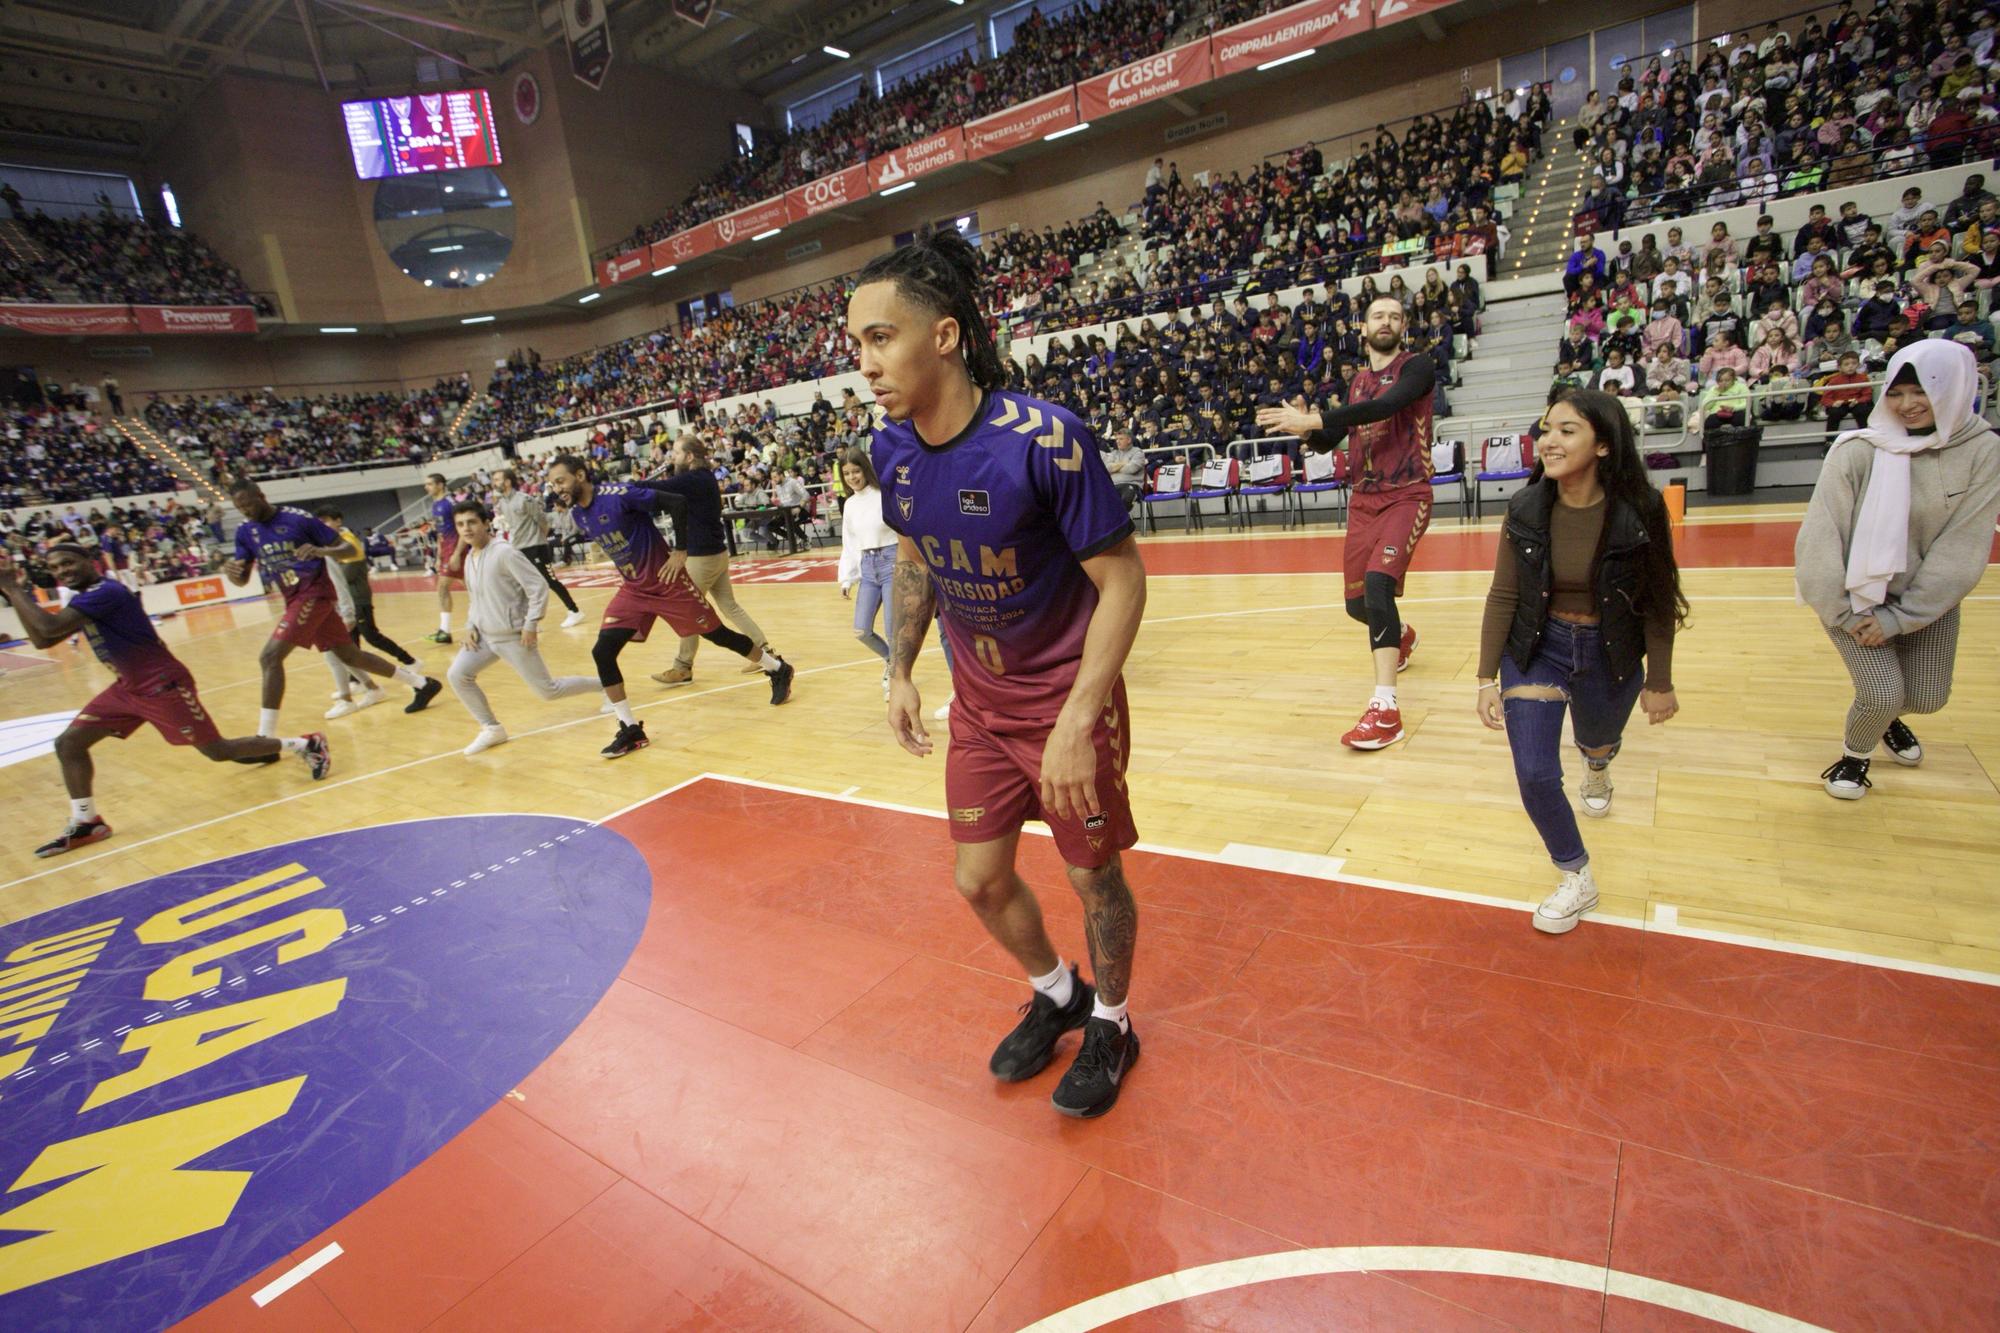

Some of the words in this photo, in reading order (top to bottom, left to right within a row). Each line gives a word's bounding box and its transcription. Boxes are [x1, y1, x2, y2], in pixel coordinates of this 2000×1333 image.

[1220, 13, 1340, 61] COMPRALAENTRADA
[1119, 53, 1177, 89] caser
[1108, 94, 1138, 109] Grupo
[1139, 79, 1180, 98] Helvetia
[983, 122, 1025, 142] ESTRELLA
[1030, 104, 1072, 127] LEVANTE
[1200, 114, 1225, 129] Norte
[906, 136, 946, 159] Asterra
[907, 149, 955, 175] Partners
[921, 535, 1018, 577] CAM
[1087, 819, 1105, 828] acb
[0, 862, 348, 1297] UCAM
